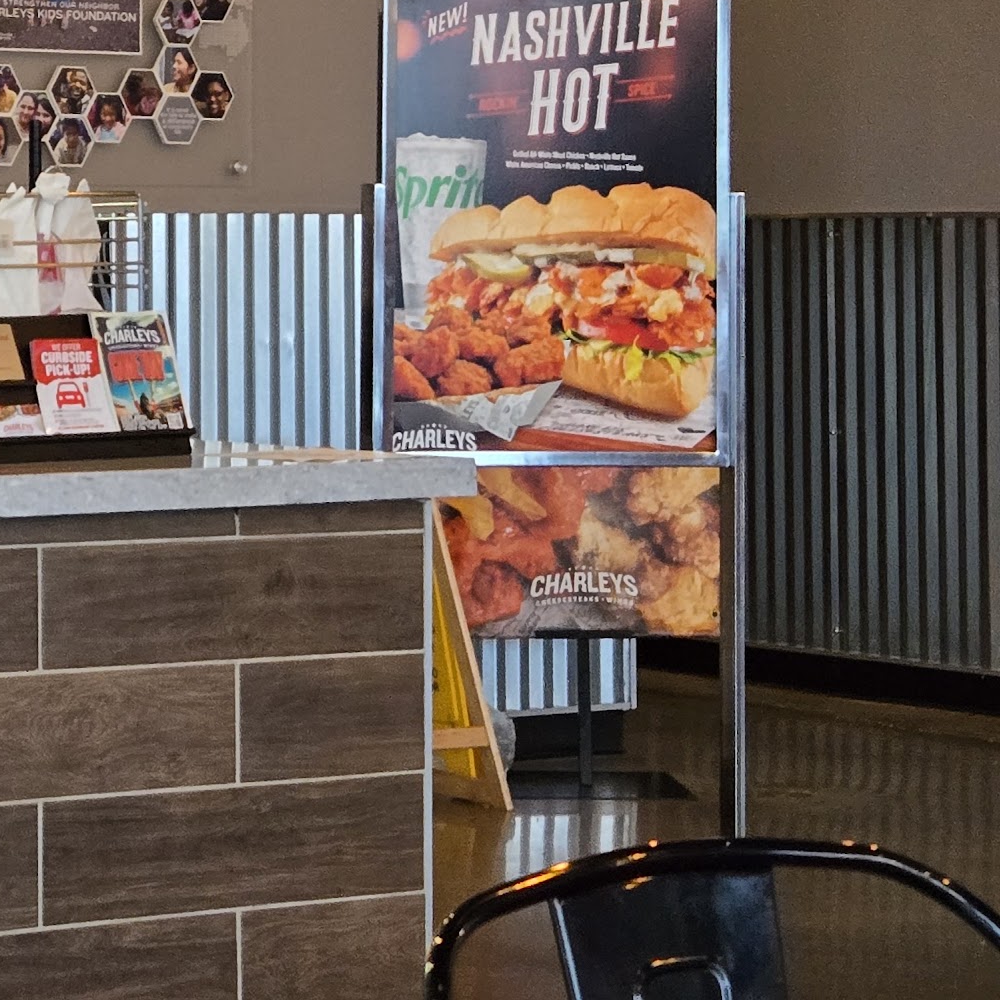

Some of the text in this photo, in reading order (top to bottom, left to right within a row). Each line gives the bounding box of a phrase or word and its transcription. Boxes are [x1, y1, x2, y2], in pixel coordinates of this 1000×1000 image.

[38, 8, 64, 20] KIDS
[66, 9, 137, 23] FOUNDATION
[427, 2, 468, 38] NEW!
[527, 62, 620, 136] HOT
[104, 328, 161, 345] CHARLEYS
[41, 351, 93, 364] CURBSIDE
[45, 363, 91, 377] PICK-UP!
[392, 428, 478, 453] CHARLEYS
[530, 571, 639, 598] CHARLEYS
